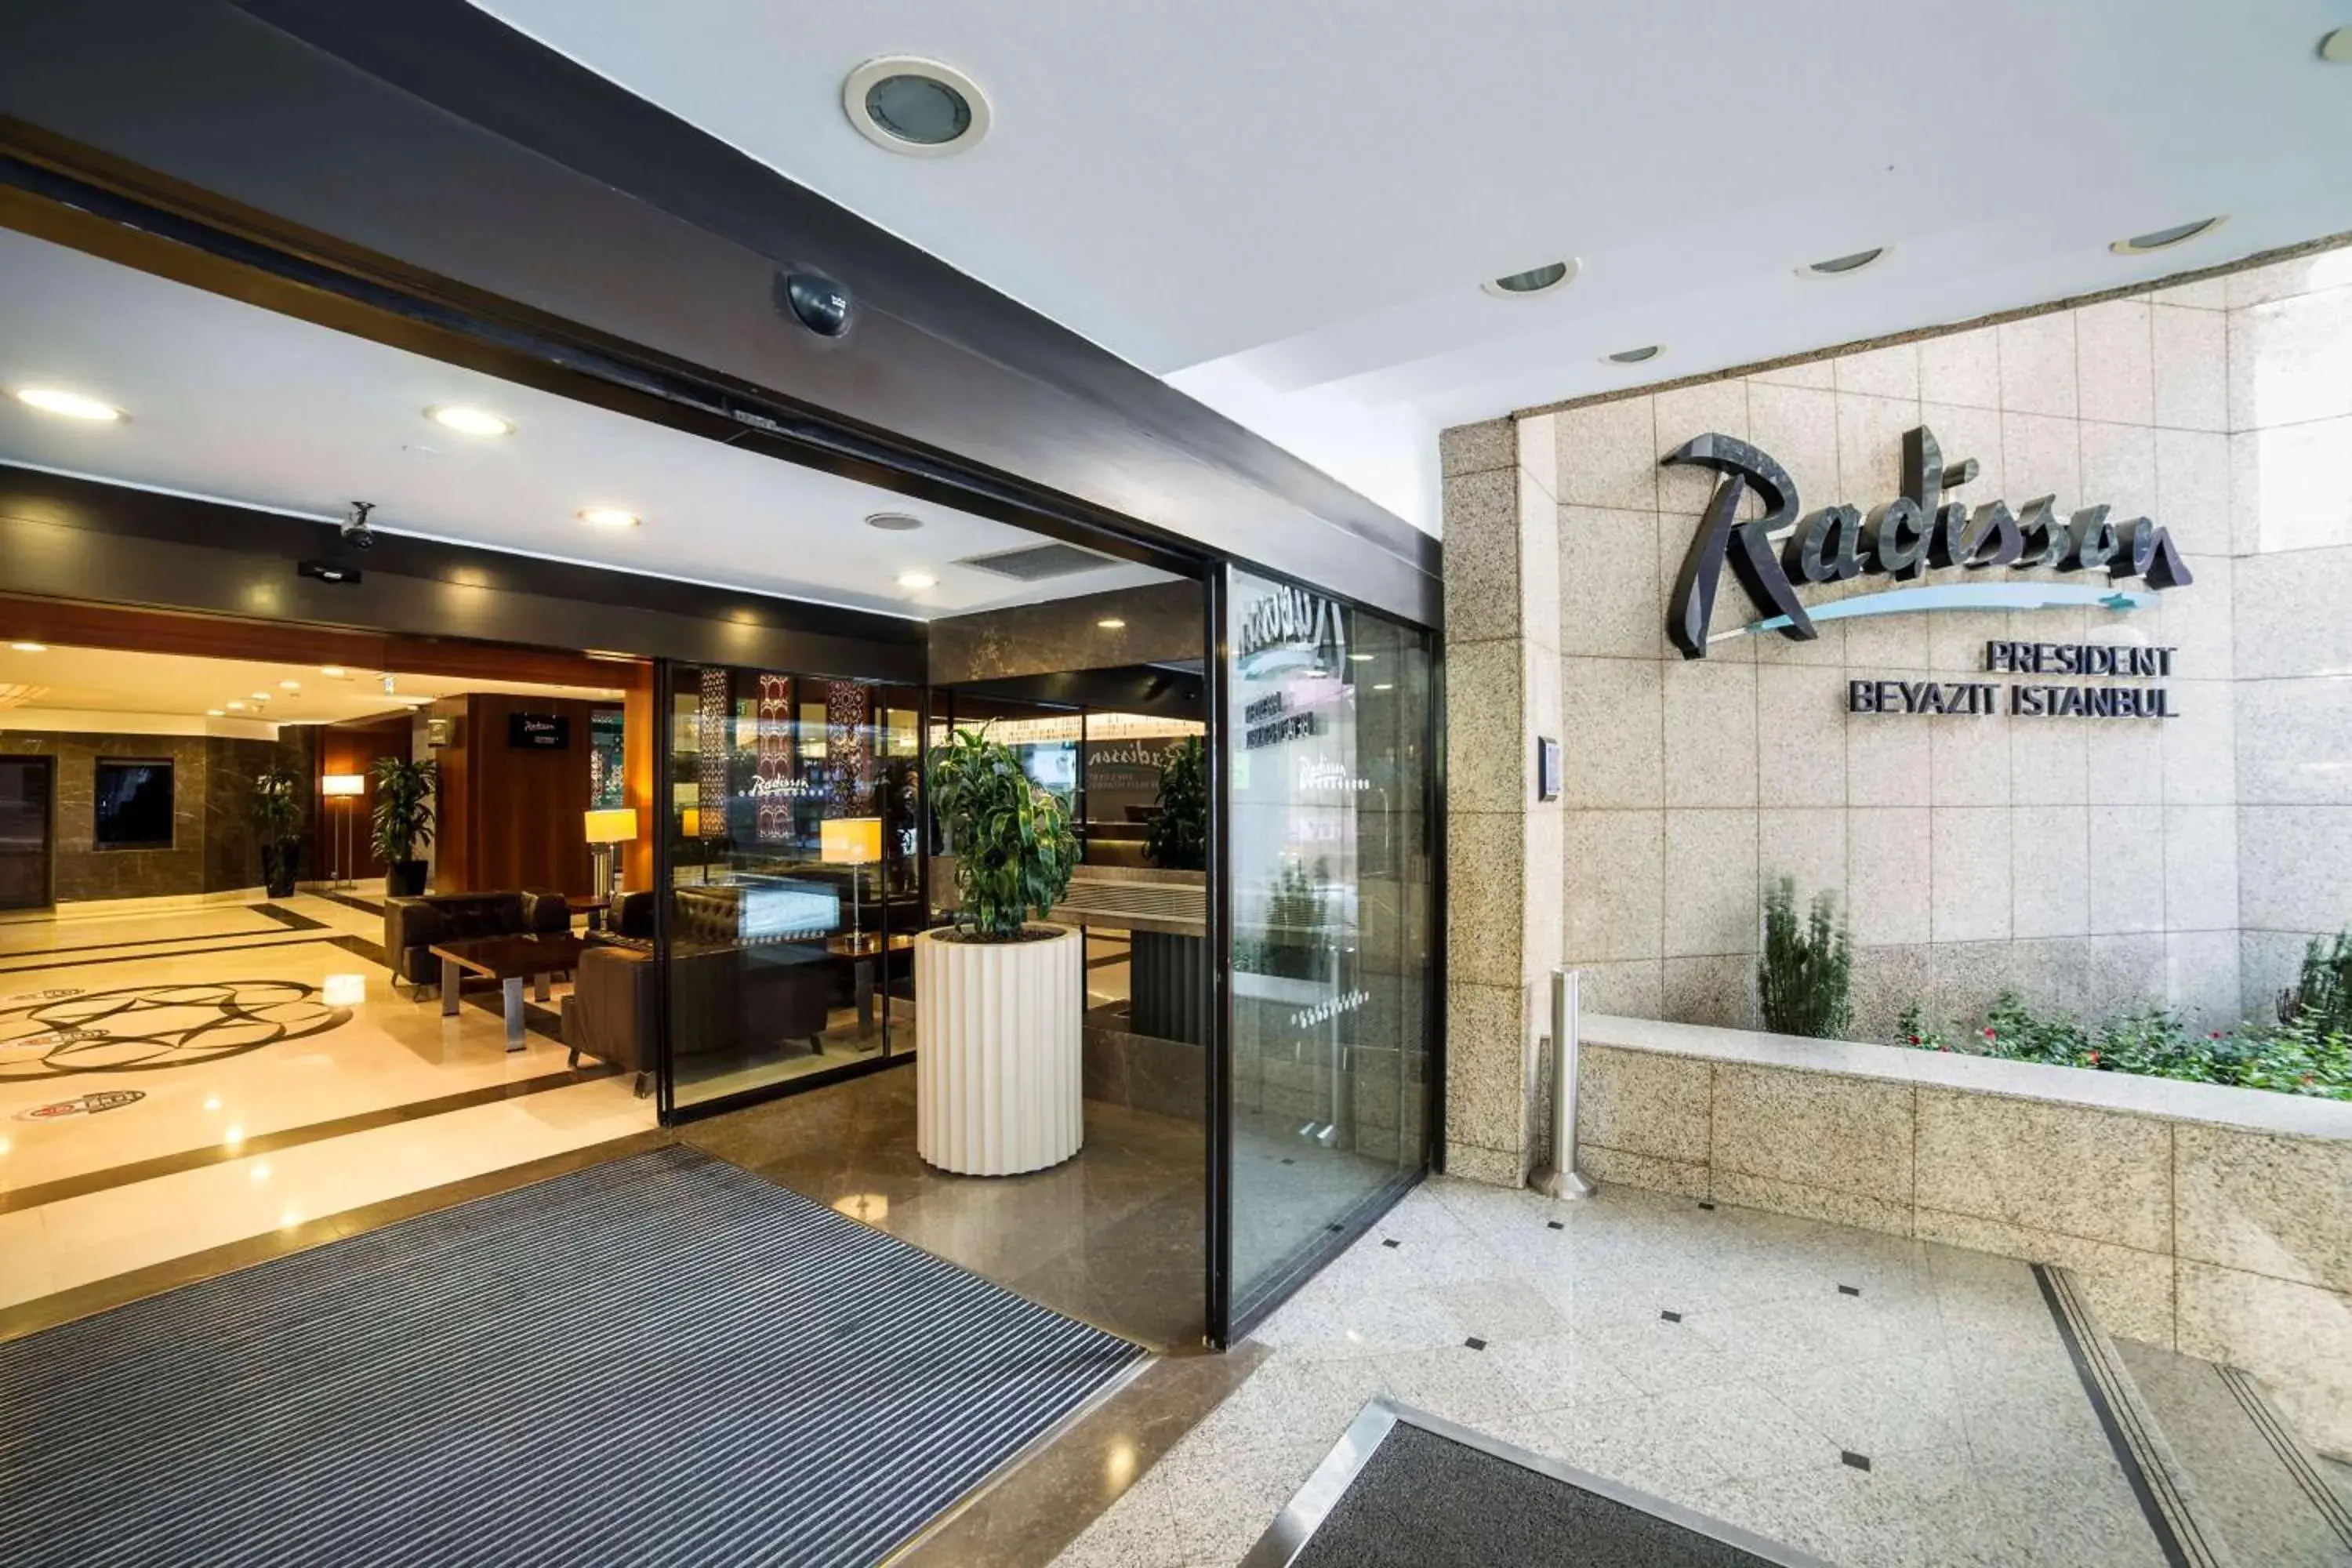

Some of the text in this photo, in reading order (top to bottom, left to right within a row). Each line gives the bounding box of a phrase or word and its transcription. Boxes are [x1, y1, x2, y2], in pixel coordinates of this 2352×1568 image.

[1661, 425, 2194, 660] Radisson
[1986, 641, 2178, 677] PRESIDENT
[1849, 680, 2180, 718] BEYAZIT ISTANBUL
[752, 772, 808, 797] Radisson
